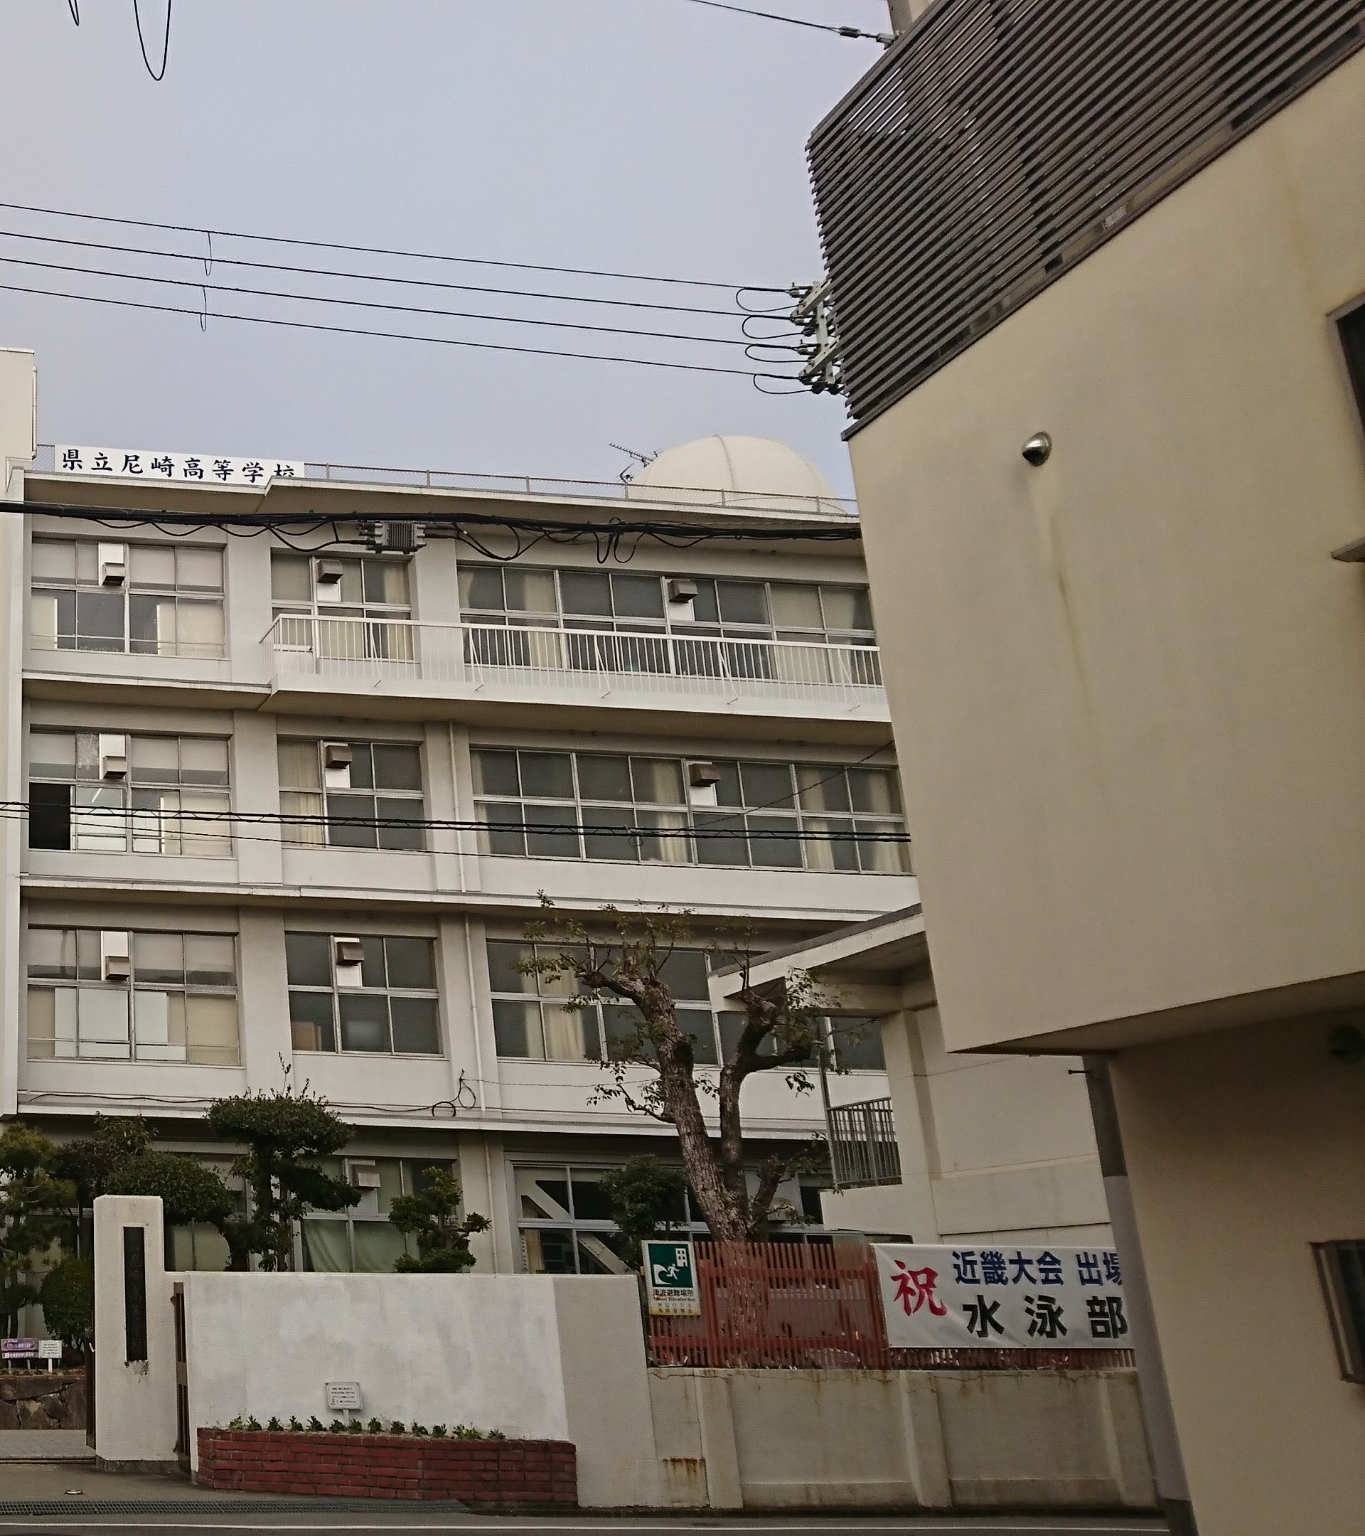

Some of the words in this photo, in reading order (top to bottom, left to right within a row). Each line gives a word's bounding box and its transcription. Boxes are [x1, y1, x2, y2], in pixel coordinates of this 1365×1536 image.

[890, 1259, 948, 1318] 祝
[952, 1250, 1064, 1286] 近畿大会
[1076, 1251, 1123, 1287] 出場
[962, 1294, 1129, 1339] 水泳部
